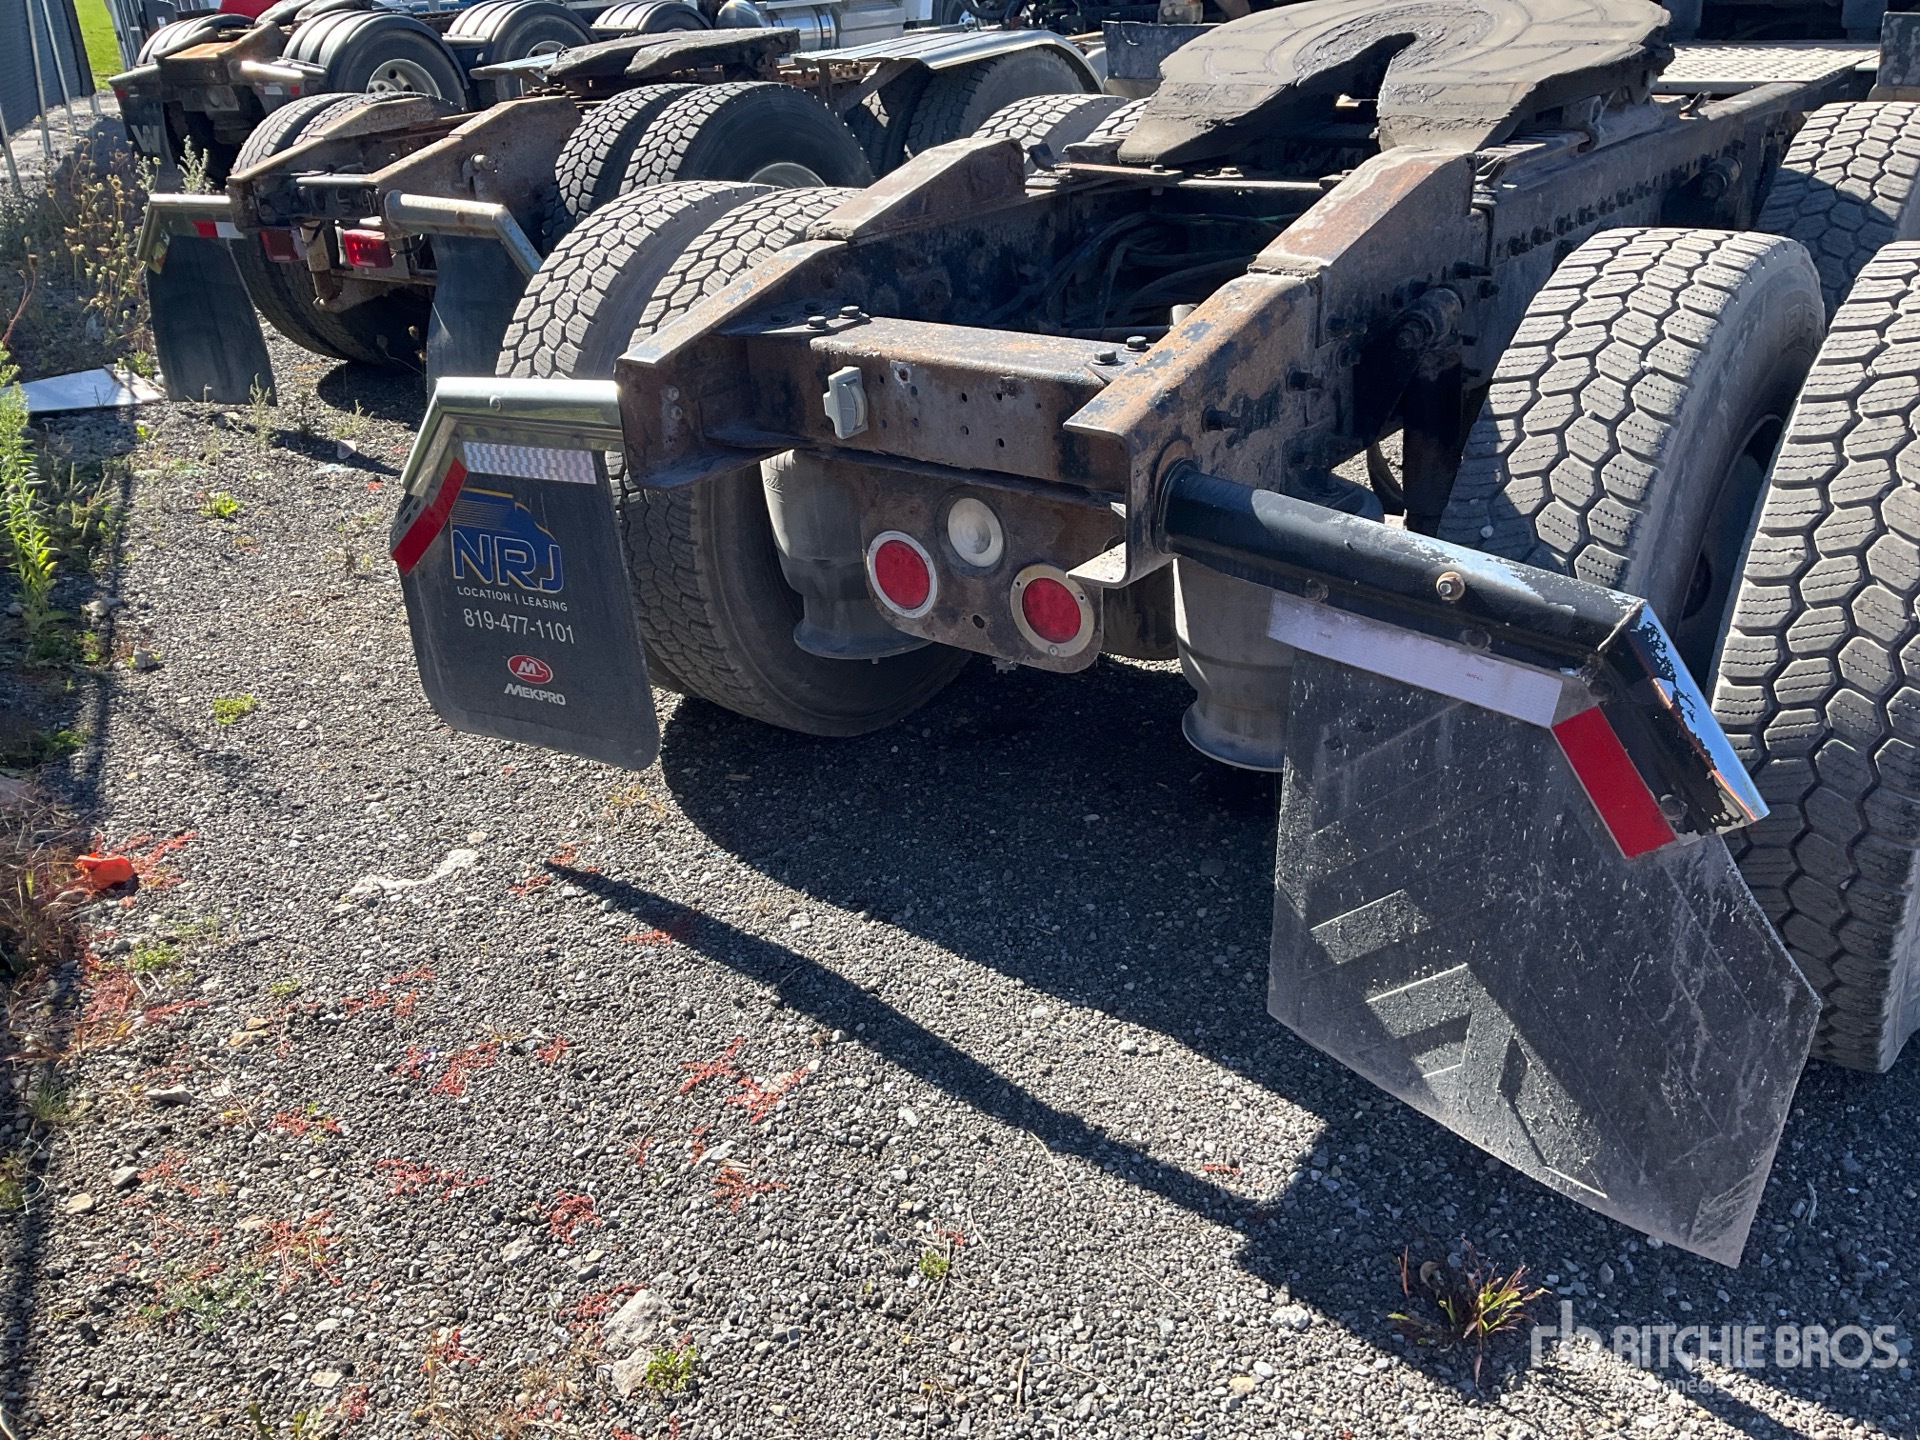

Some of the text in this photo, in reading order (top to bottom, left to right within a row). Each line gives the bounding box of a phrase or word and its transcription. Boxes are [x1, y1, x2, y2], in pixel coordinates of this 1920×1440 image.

[451, 529, 564, 594] NRJ
[457, 586, 511, 603] LOCATION
[521, 595, 568, 612] LEASING
[463, 608, 575, 644] 819-477-1101
[503, 683, 566, 706] MEKPRO
